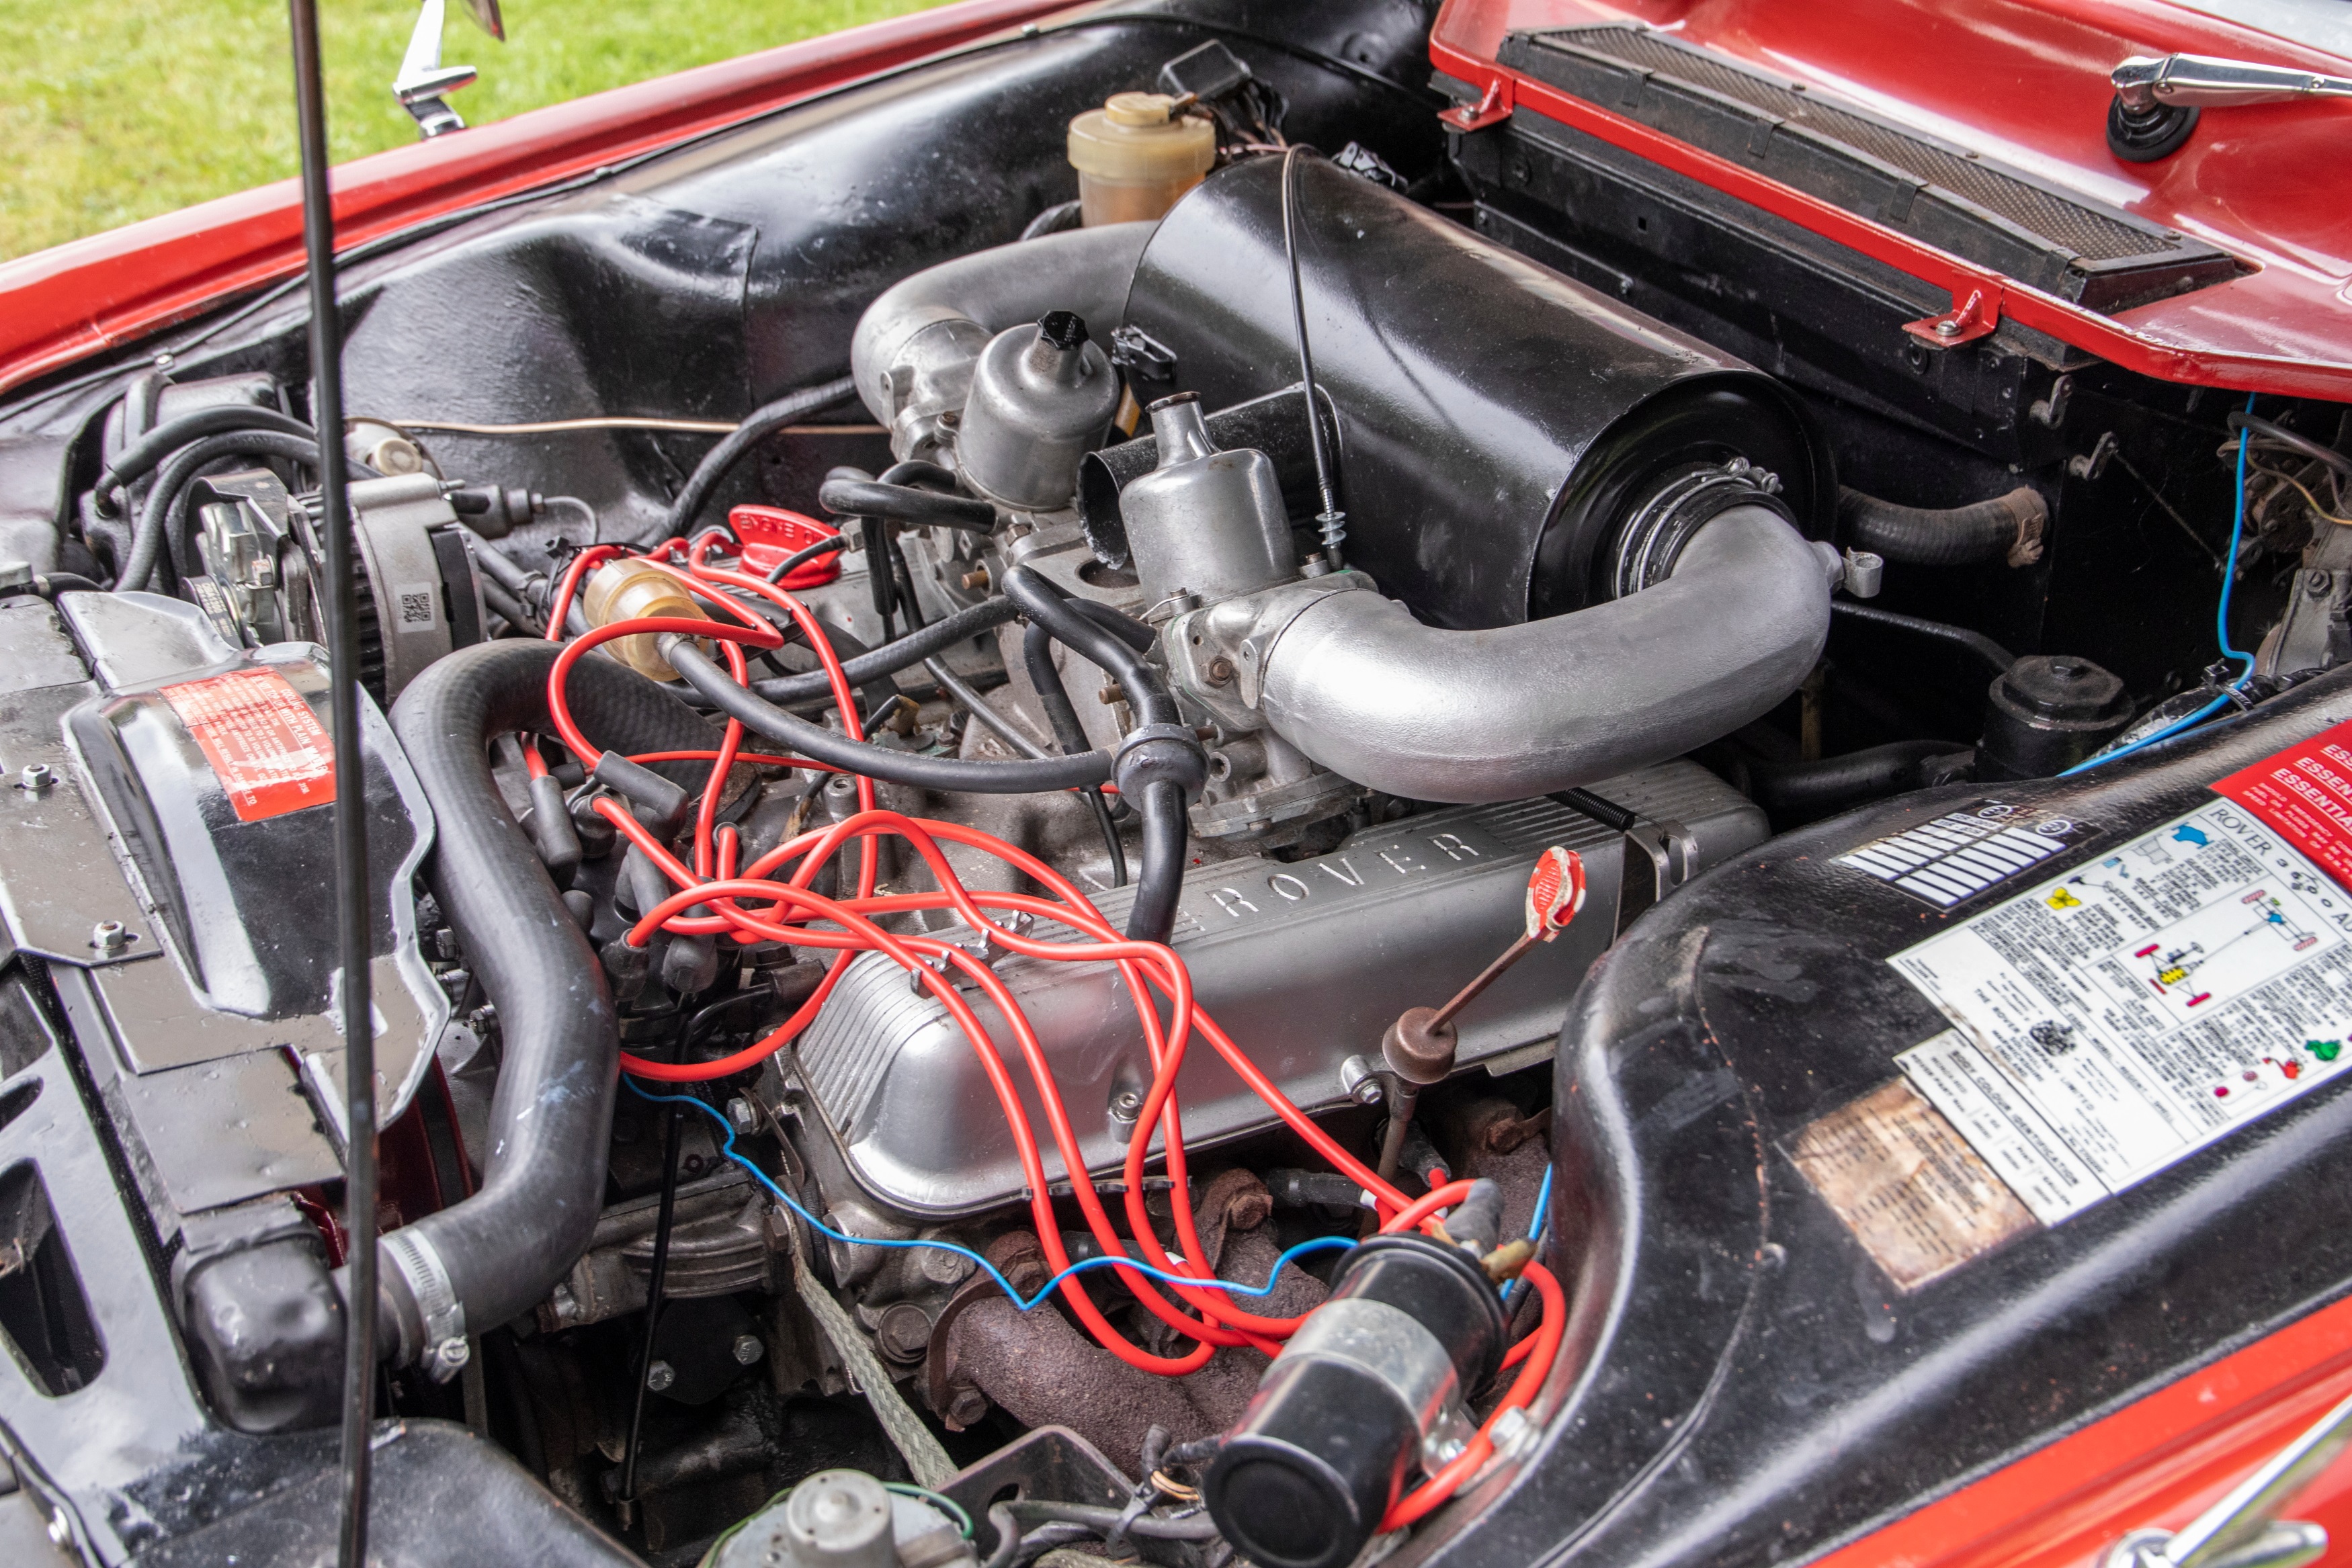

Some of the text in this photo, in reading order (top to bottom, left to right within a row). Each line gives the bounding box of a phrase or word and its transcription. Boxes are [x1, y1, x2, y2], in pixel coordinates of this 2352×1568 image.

[278, 707, 298, 724] WITH
[290, 724, 312, 744] PLAIN
[280, 688, 322, 736] COOLING SYSTEM
[245, 795, 259, 805] TO
[2295, 755, 2352, 799] ESSEN
[2208, 805, 2276, 859] ROVER
[1205, 833, 1480, 917] ROVER
[1990, 1005, 2022, 1035] ROVER
[2018, 1034, 2062, 1075] COMPANY
[2058, 1076, 2097, 1112] LIMITED
[1973, 1075, 2014, 1113] COLOUR
